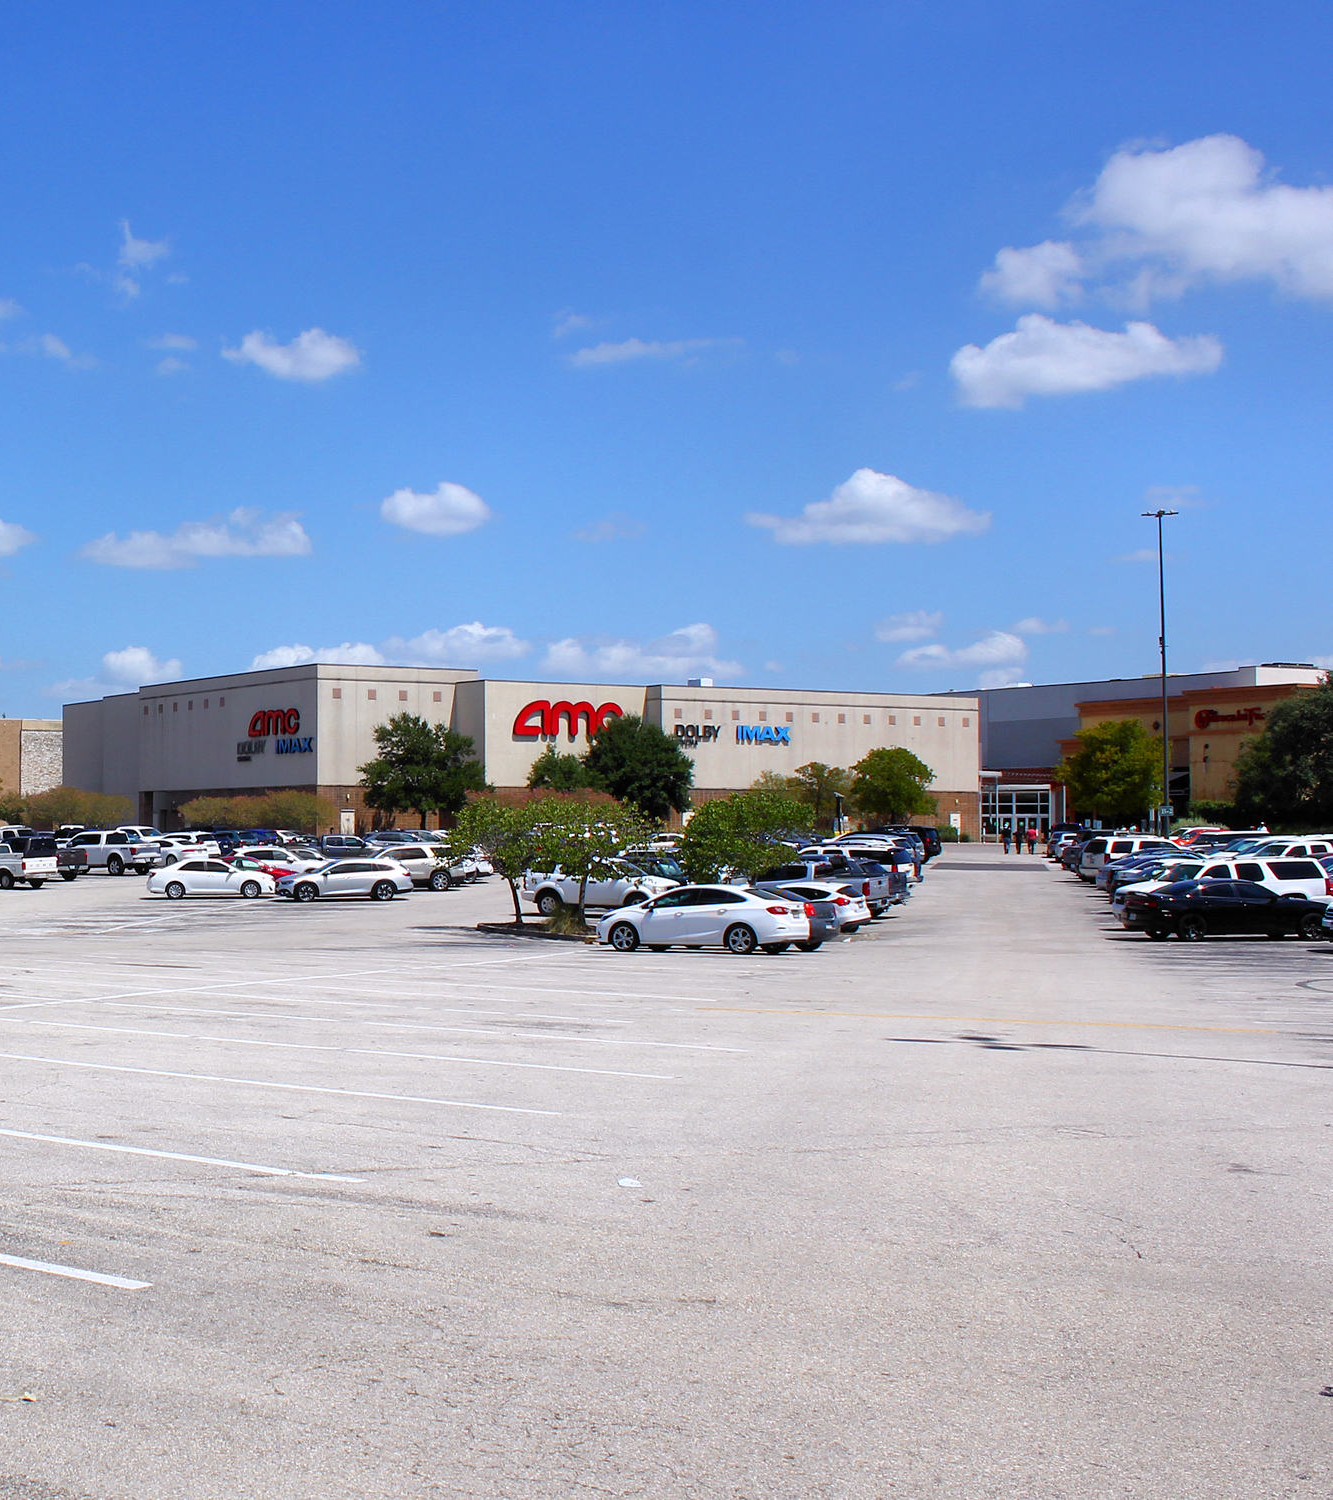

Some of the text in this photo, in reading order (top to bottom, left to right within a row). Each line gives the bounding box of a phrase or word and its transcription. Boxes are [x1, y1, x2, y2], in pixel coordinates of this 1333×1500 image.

[674, 724, 791, 745] DOLBY IMAX
[275, 737, 313, 754] IMAX
